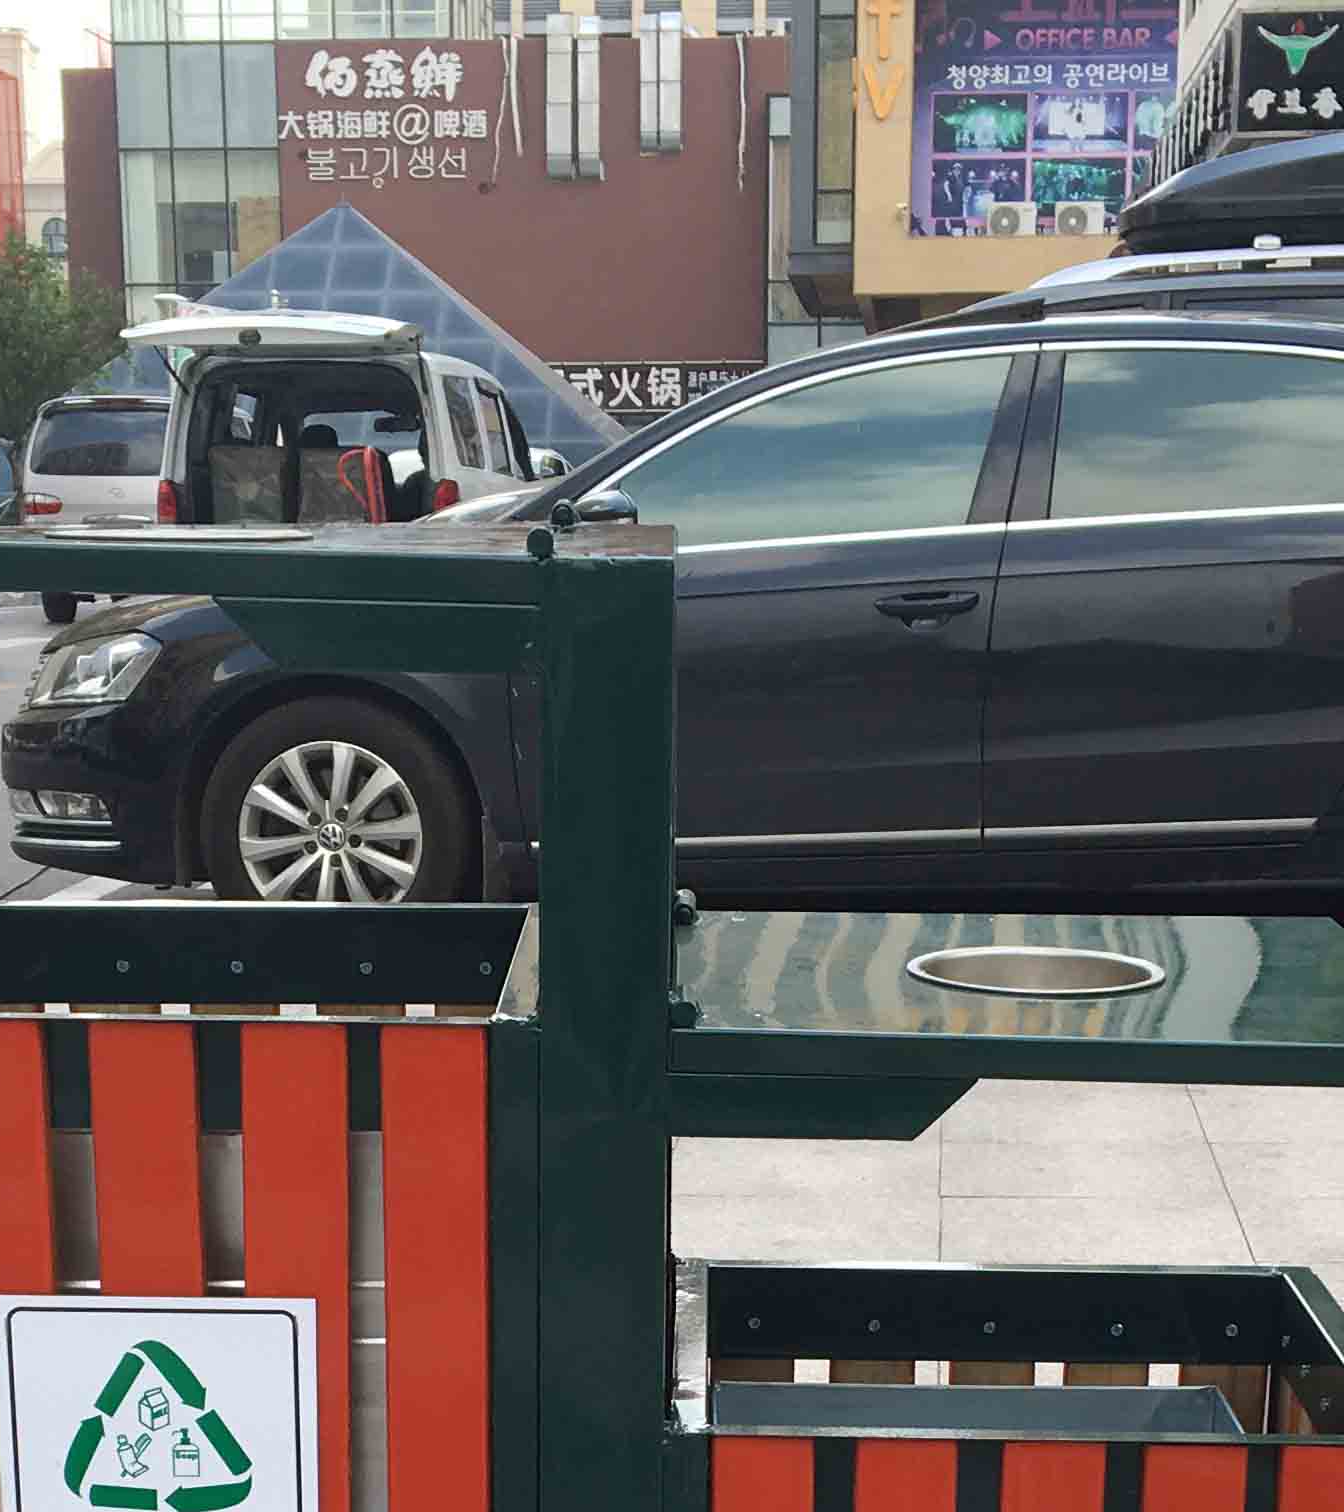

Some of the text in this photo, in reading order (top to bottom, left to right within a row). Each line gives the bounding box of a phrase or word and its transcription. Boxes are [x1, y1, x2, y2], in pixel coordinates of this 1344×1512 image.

[1015, 27, 1151, 49] OFFICE BAR
[946, 63, 1170, 89] 청양최고의 공연라이브
[306, 147, 467, 181] 불고기 생선
[554, 366, 683, 407] 式火锅
